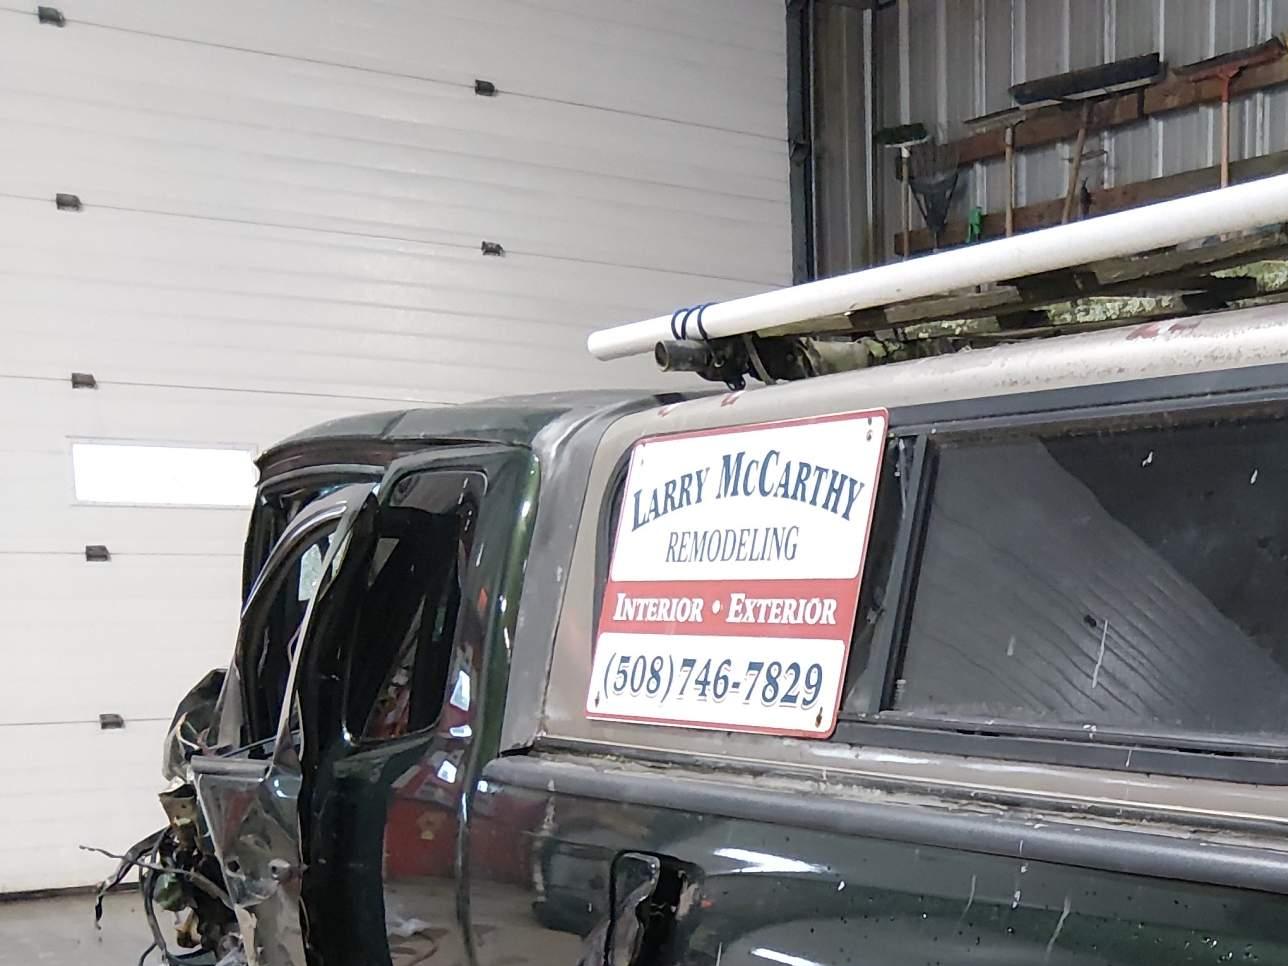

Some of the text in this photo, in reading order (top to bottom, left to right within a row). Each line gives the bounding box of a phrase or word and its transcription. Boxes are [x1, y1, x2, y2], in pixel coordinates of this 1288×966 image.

[632, 467, 710, 531] LARRY
[665, 526, 799, 562] REMODELING
[613, 592, 837, 624] INTERIOR EXTERIOR
